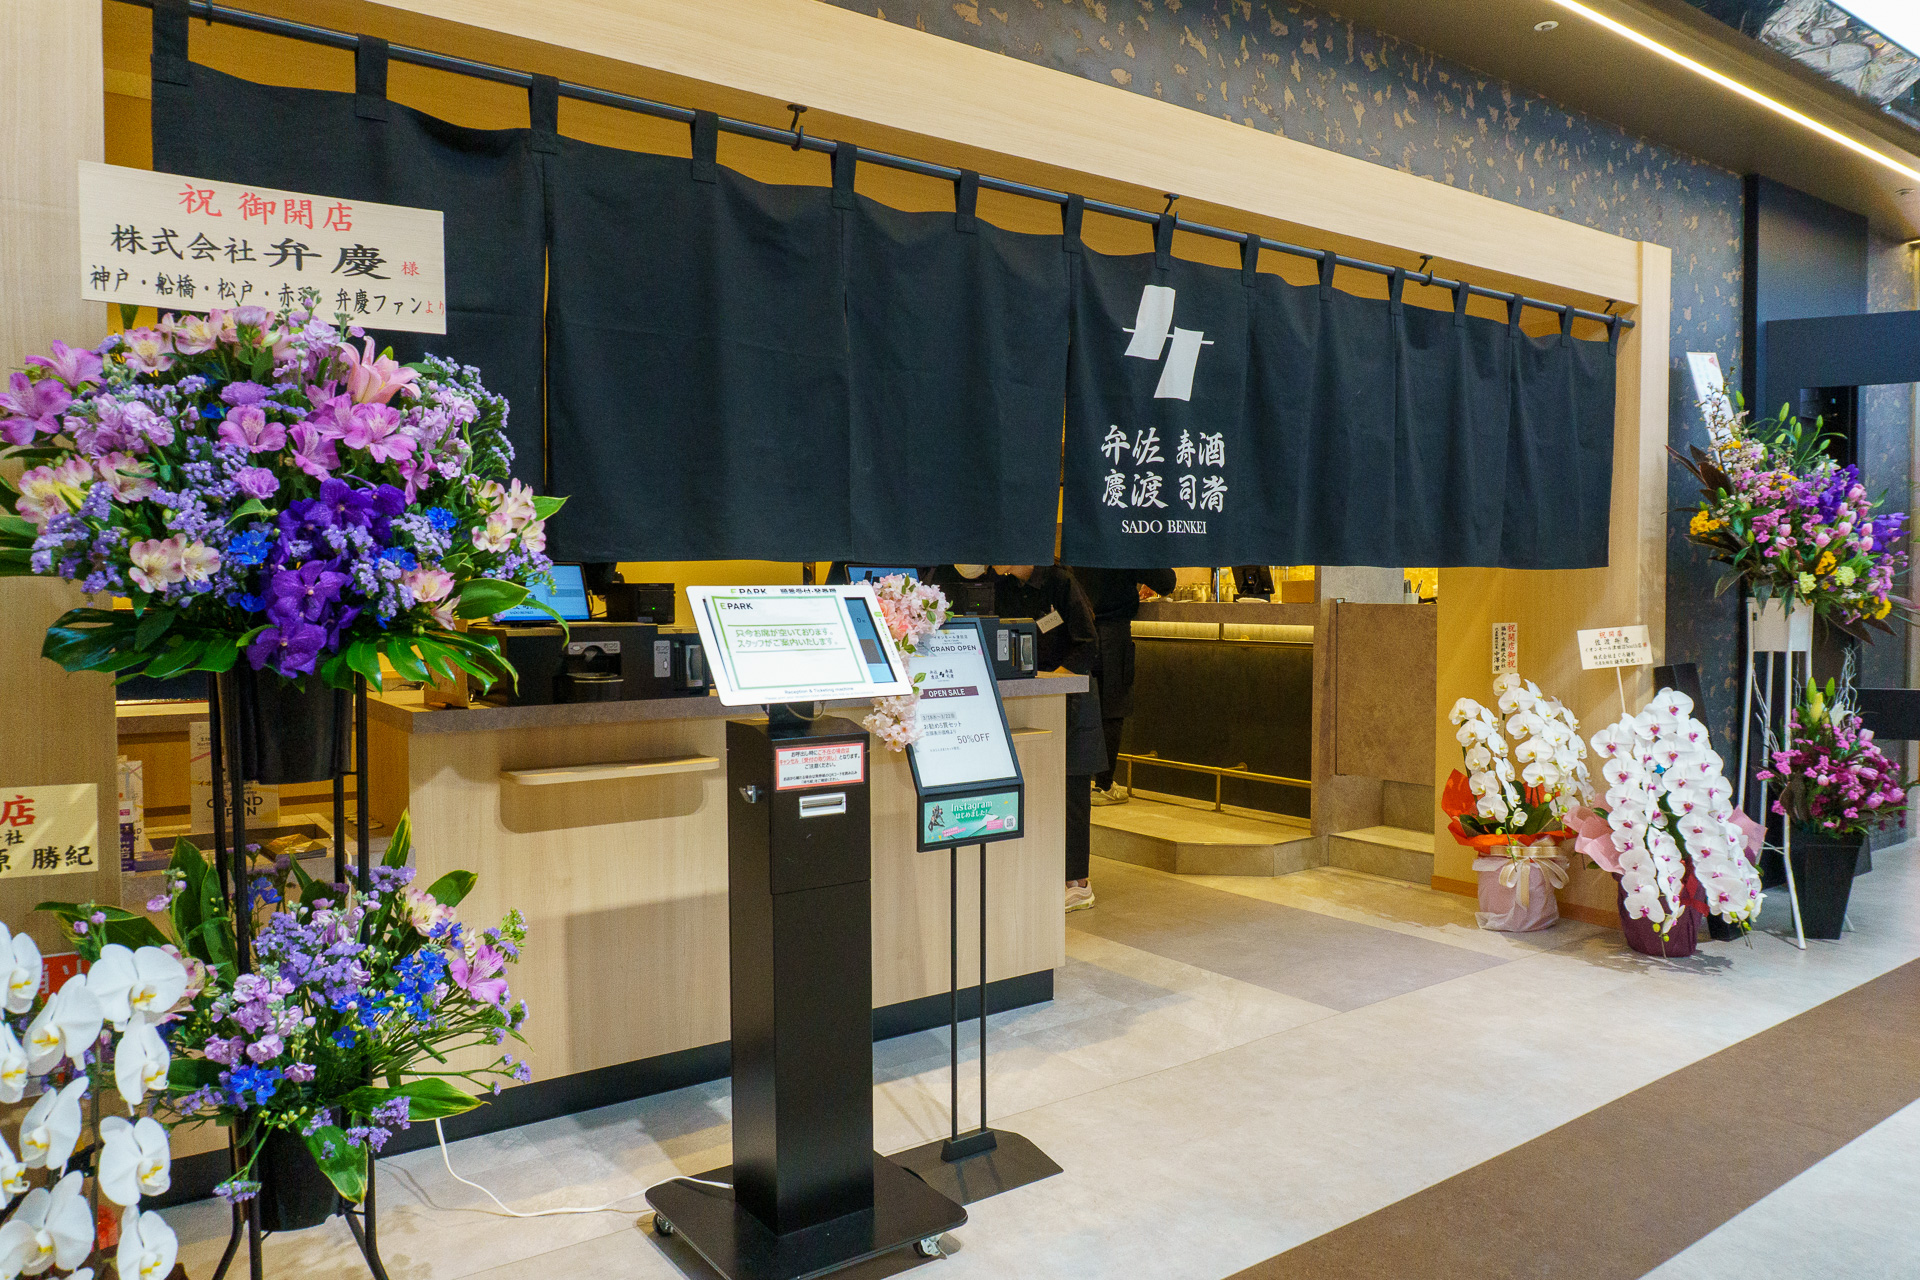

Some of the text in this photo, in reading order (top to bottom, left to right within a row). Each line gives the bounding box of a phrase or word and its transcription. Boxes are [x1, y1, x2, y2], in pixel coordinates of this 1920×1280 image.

[1121, 519, 1207, 535] SADO BENKEI
[720, 602, 753, 610] EPARK
[735, 627, 834, 638] 只今お席が空いております。
[737, 637, 839, 648] スタッフがご案内いたします。
[928, 688, 966, 698] OPEN SALE
[957, 733, 990, 744] 50%OFF
[952, 801, 992, 812] Instagram
